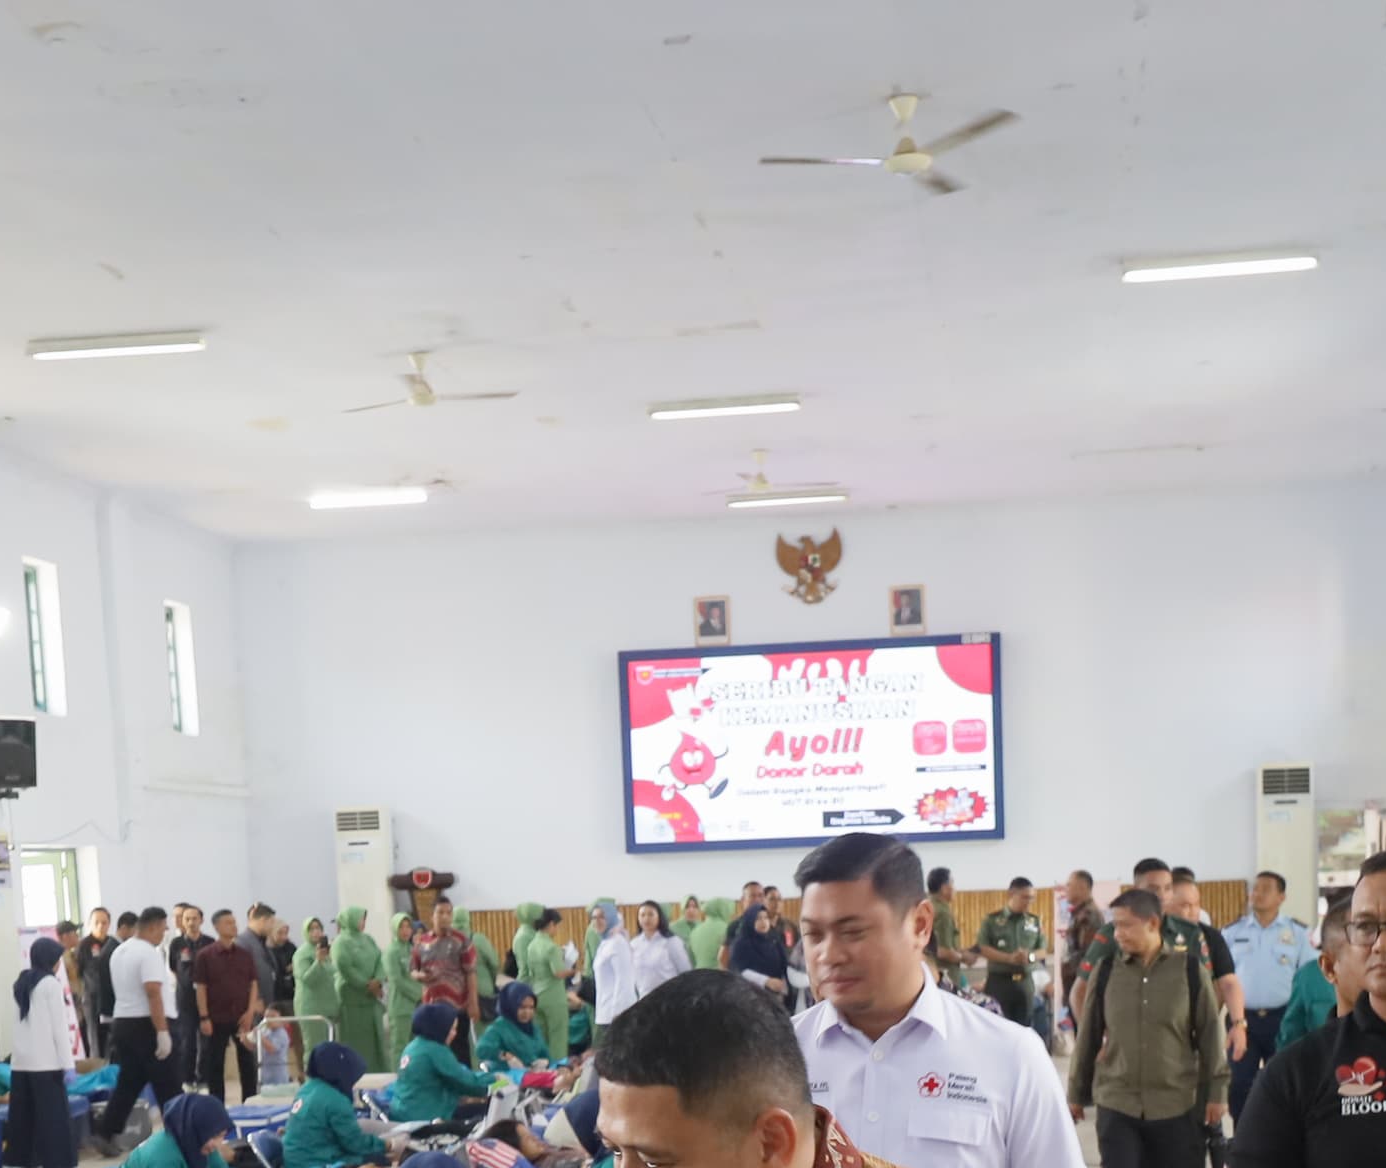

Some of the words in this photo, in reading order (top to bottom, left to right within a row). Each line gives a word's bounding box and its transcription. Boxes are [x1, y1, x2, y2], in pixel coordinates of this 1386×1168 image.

[711, 678, 808, 702] SERIBU
[813, 673, 924, 697] TANGAN
[764, 728, 865, 761] Ayo!!!
[756, 765, 808, 779] Donor
[812, 761, 864, 778] Darah
[948, 1072, 978, 1084] Palang
[947, 1082, 975, 1091] Merah
[946, 1092, 988, 1103] Indonesia
